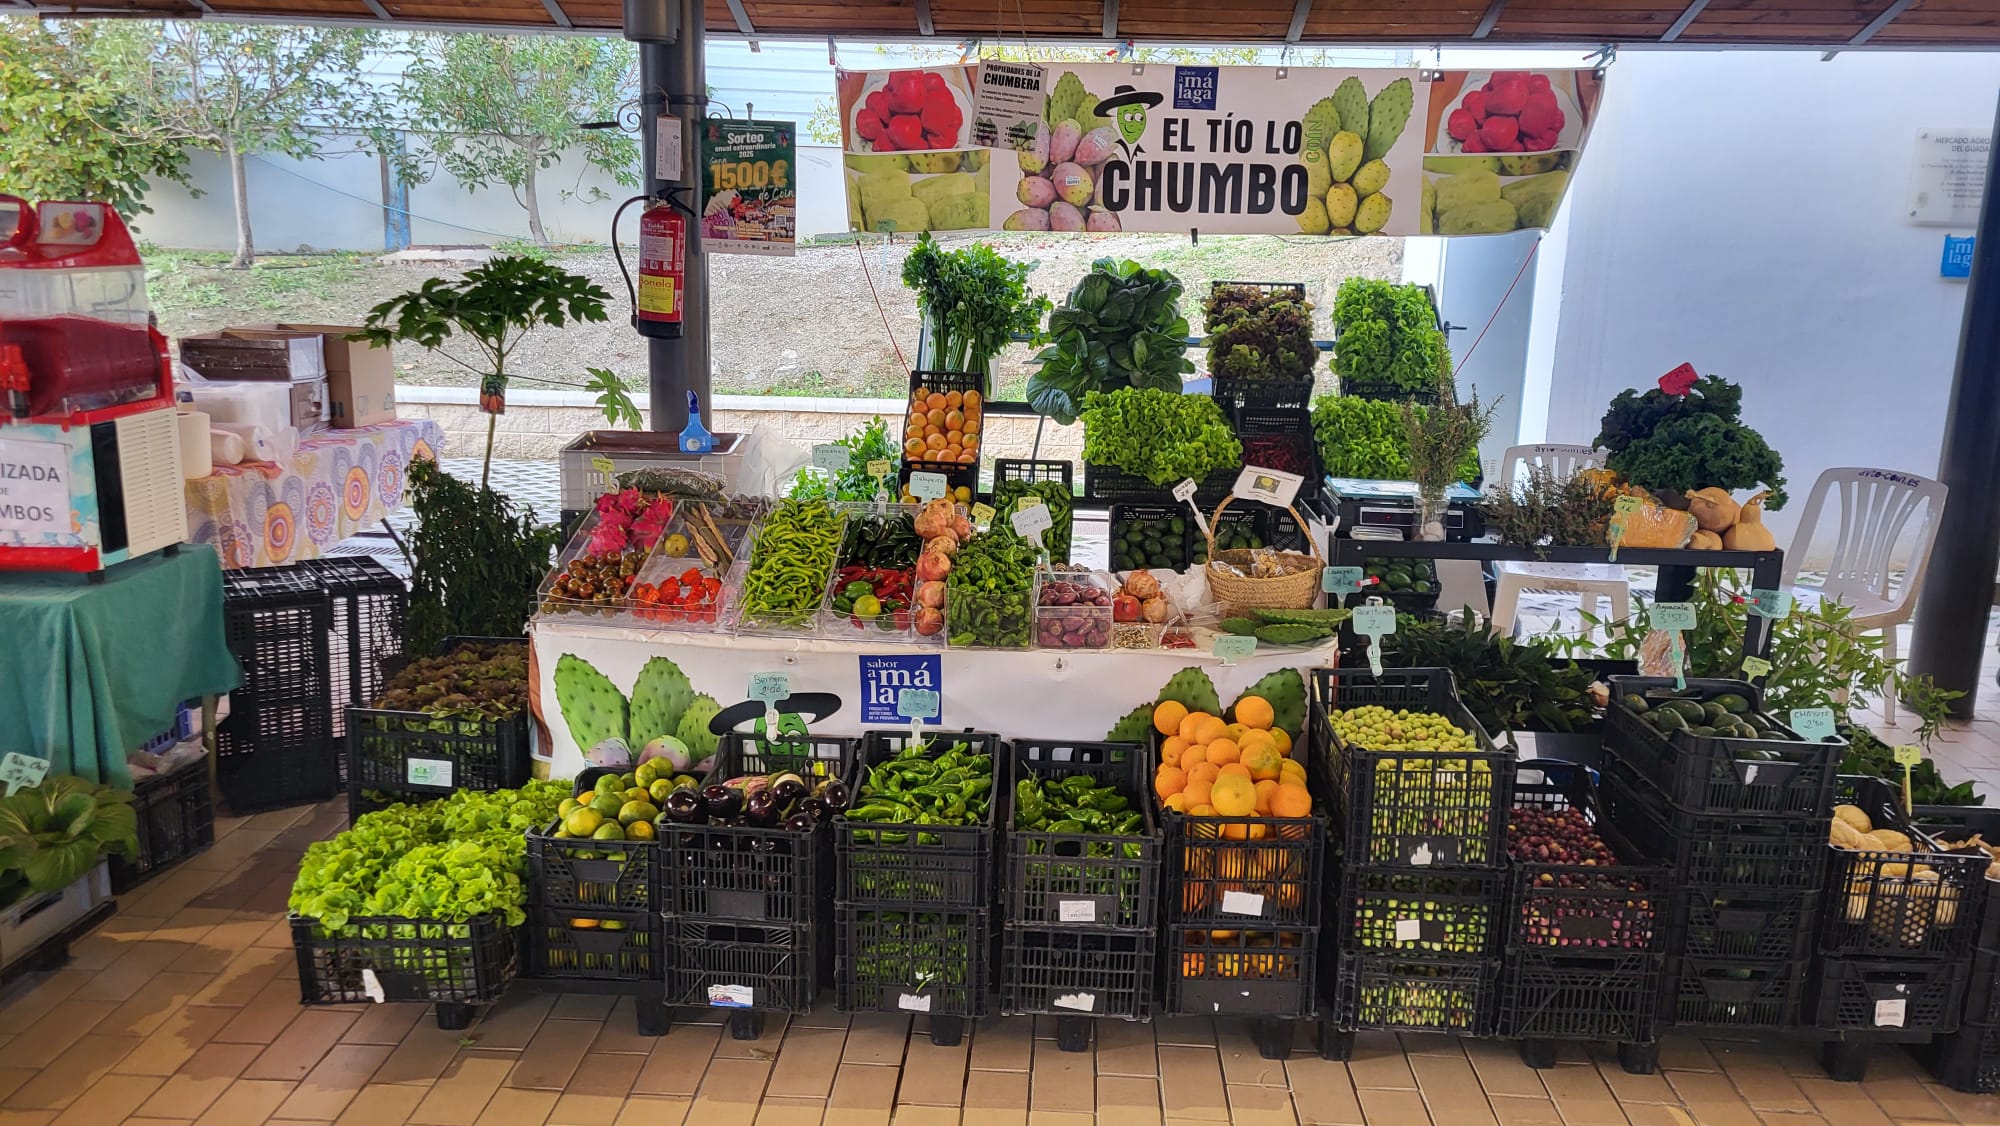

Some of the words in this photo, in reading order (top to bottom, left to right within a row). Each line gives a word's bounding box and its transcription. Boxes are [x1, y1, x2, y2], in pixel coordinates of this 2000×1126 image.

[986, 64, 1024, 75] PROPIEDADES
[984, 73, 1040, 91] CHUMBERA
[727, 132, 764, 144] Sorteo
[1162, 117, 1195, 153] EL
[1206, 112, 1254, 154] TÍO
[1266, 120, 1302, 155] LO
[1935, 137, 1969, 145] MERCADO
[733, 143, 776, 152] extraordinario
[1103, 159, 1308, 215] CHUMBO
[1655, 603, 1689, 612] Aguacate
[867, 659, 898, 668] sabor
[867, 669, 877, 678] a
[879, 661, 934, 687] má
